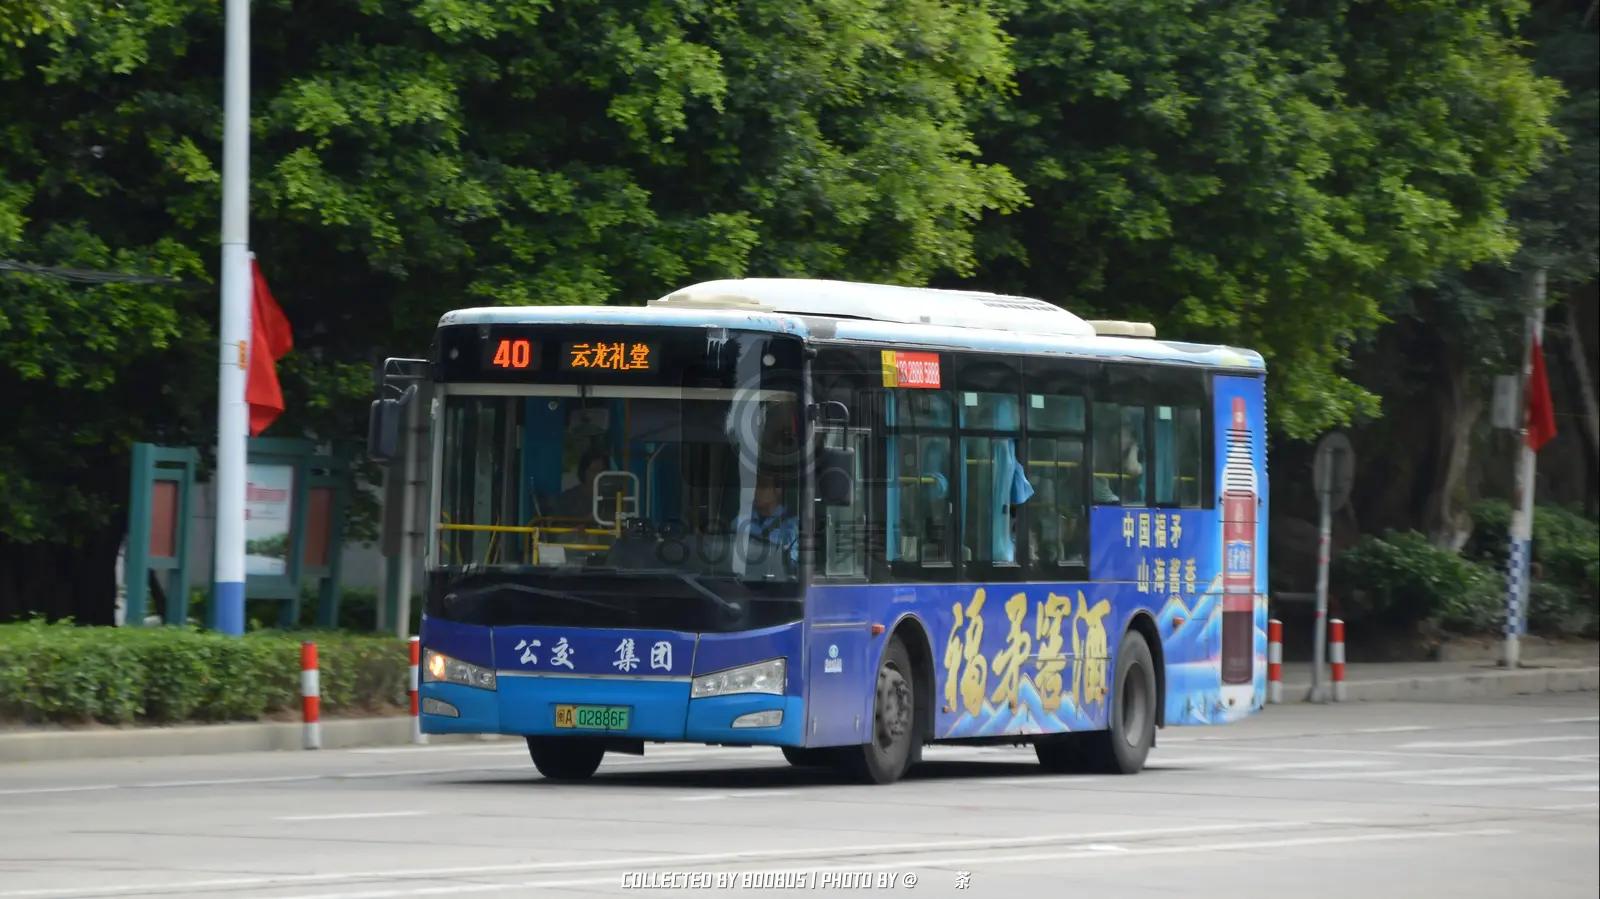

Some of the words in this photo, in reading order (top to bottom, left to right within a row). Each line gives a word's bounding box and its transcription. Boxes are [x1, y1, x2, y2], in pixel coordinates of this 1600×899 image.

[492, 339, 531, 368] 40
[570, 342, 650, 370] 云龙礼堂
[1123, 511, 1182, 548] 中国福矛
[1137, 556, 1196, 594] 山海酱香
[513, 636, 575, 669] 公交
[612, 637, 673, 672] 集团
[579, 709, 627, 728] 02886F
